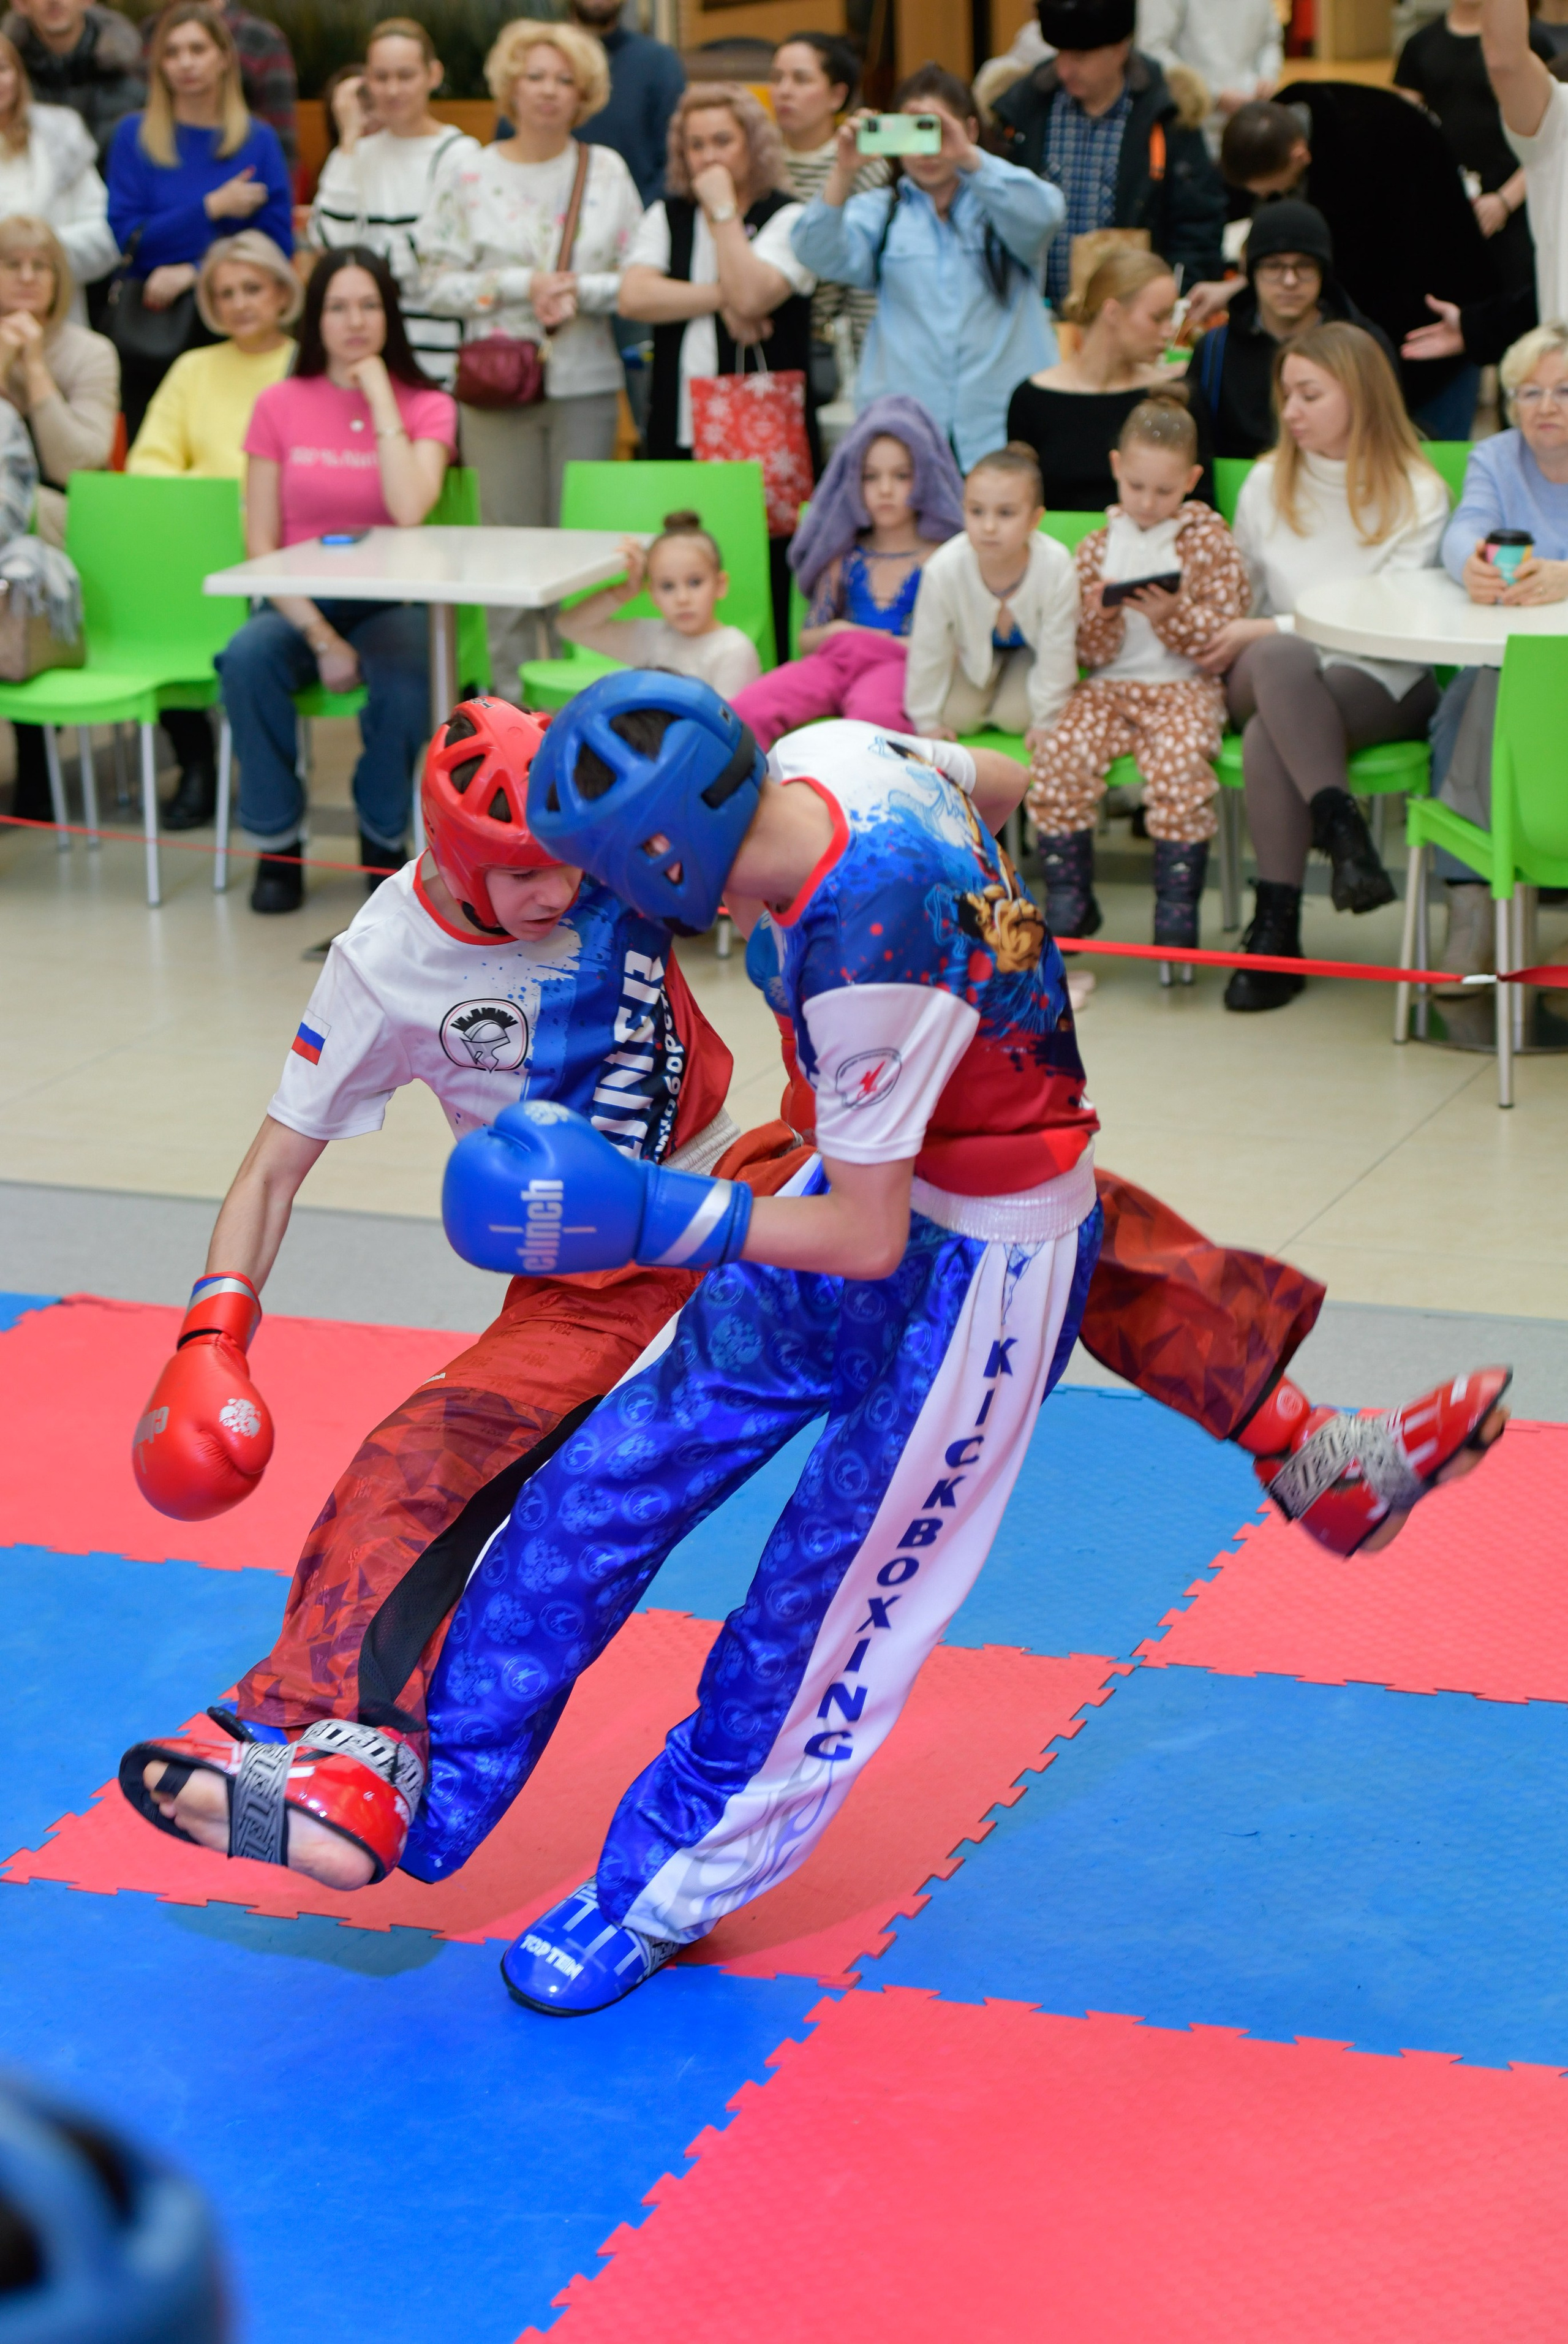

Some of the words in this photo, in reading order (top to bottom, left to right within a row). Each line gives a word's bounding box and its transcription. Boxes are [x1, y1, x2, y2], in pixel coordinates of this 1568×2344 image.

[517, 1179, 564, 1271] clinch
[803, 1337, 1018, 1761] KICKBOXING
[519, 1933, 551, 1958] TOP
[546, 1945, 584, 1981] TEN
